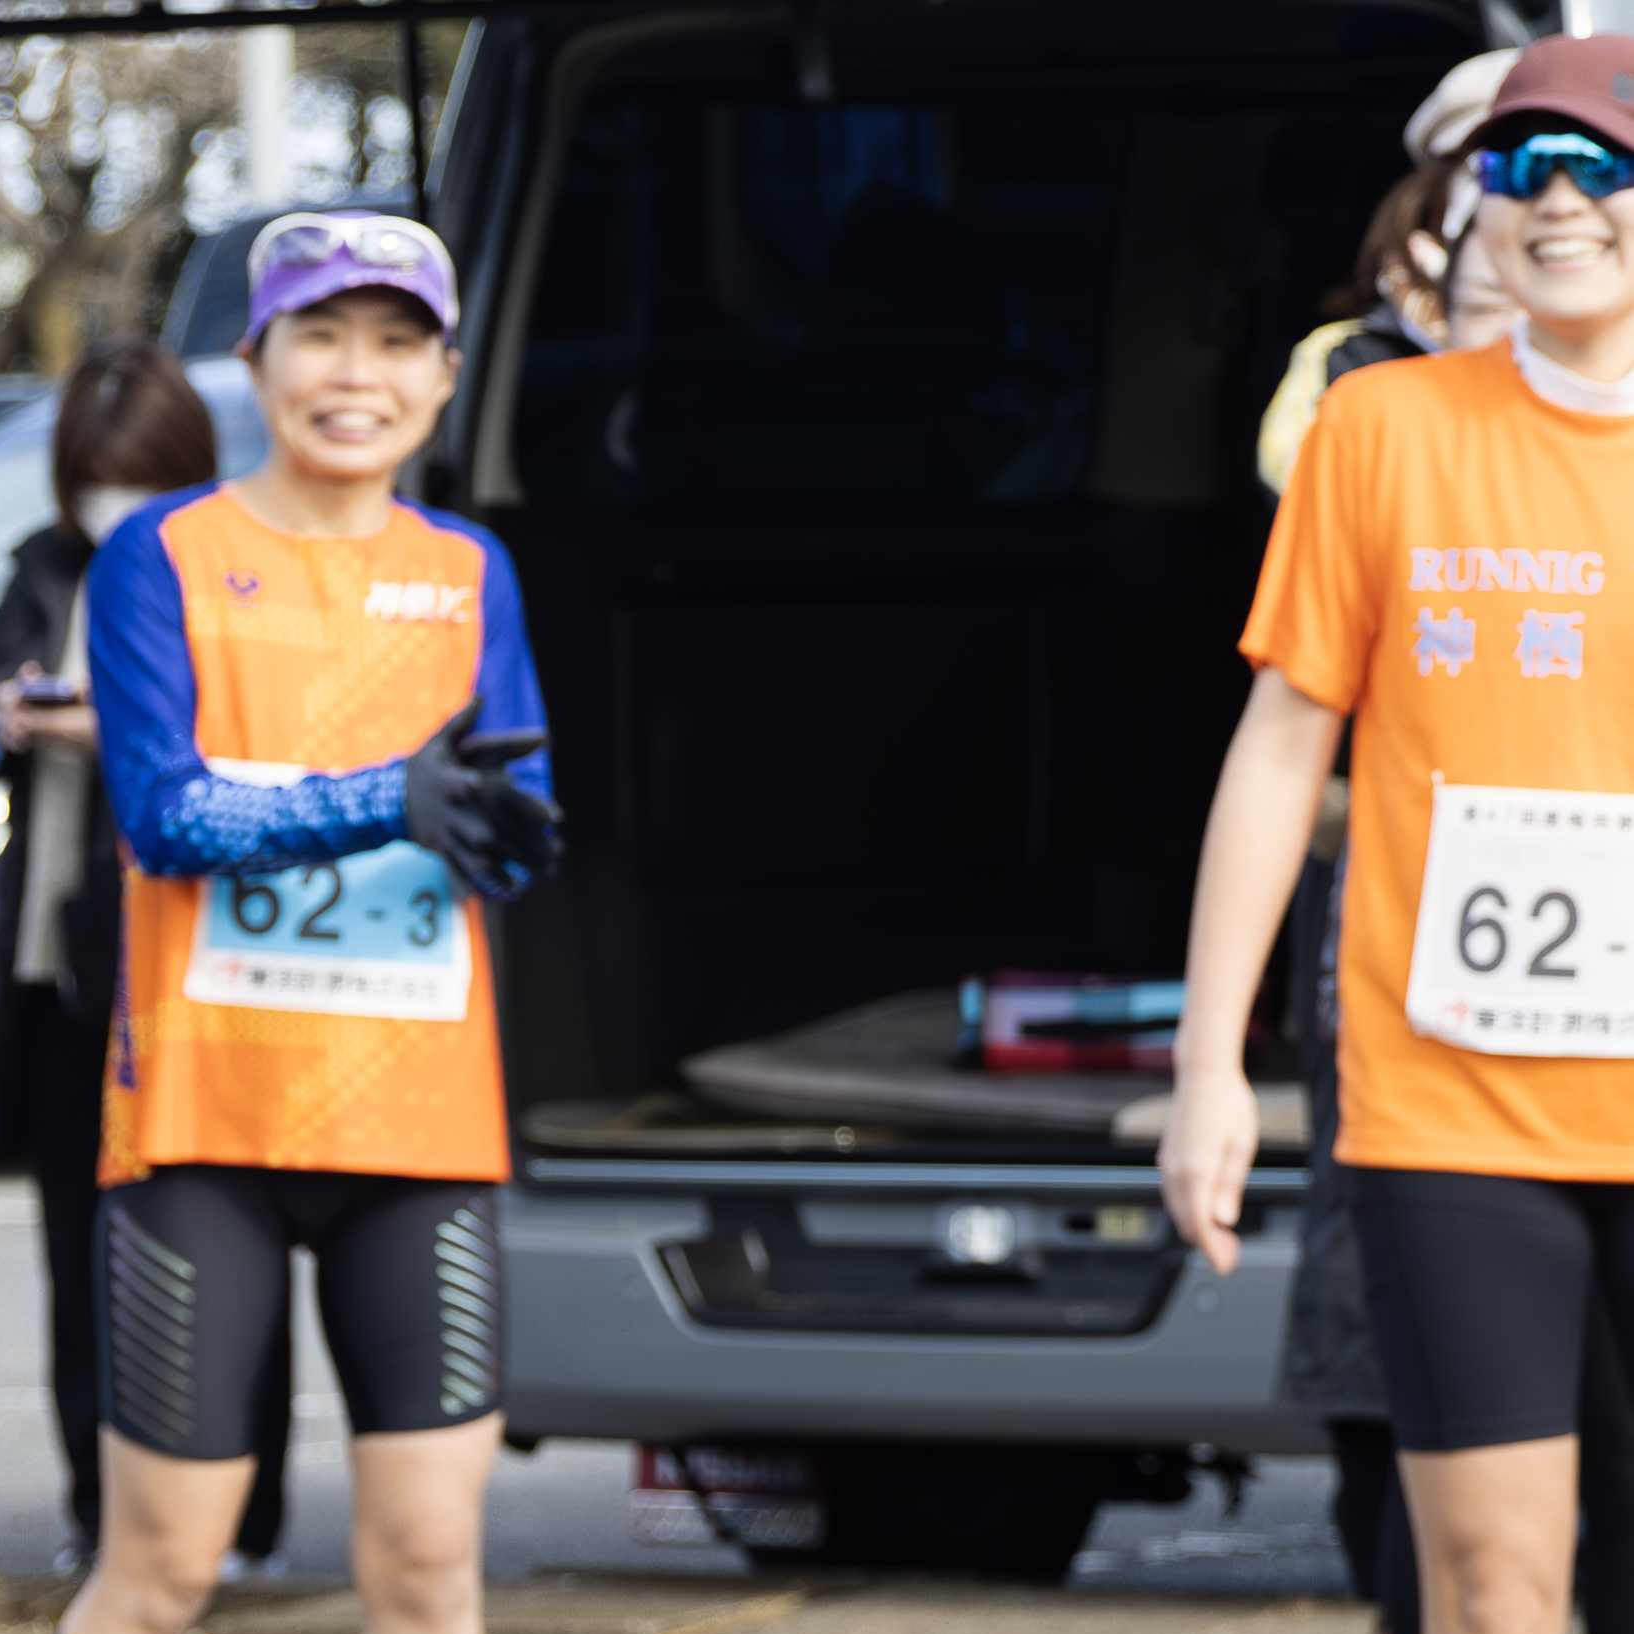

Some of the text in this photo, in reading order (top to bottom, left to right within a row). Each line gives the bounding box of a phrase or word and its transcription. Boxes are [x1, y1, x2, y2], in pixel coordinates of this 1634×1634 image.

[1410, 547, 1606, 595] RUNNIG
[1411, 606, 1587, 681] 神栖
[233, 865, 341, 939] 62
[409, 890, 441, 947] 3
[1459, 886, 1578, 977] 62
